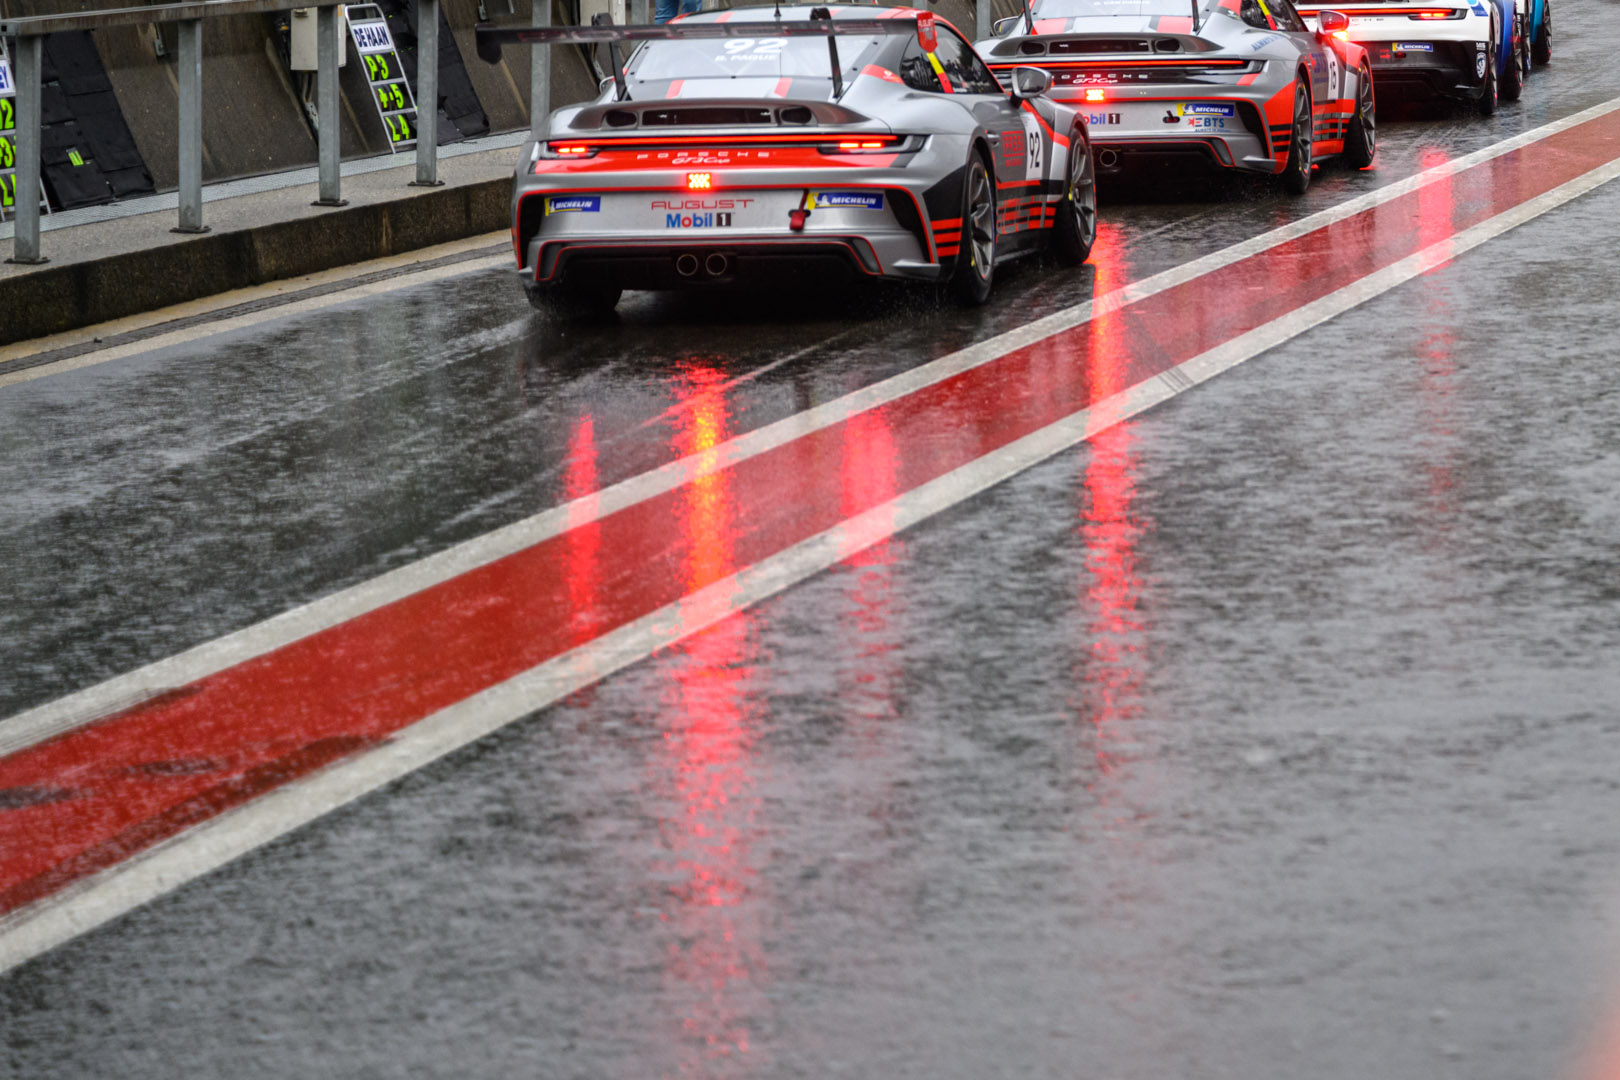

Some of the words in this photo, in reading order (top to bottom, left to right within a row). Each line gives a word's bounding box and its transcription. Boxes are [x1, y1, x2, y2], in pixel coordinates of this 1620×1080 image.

[353, 27, 368, 48] DE
[364, 25, 390, 47] HAAN
[723, 38, 789, 55] 92
[364, 54, 389, 81] P3
[1329, 61, 1337, 90] 15
[1195, 106, 1229, 114] MICHELIN
[385, 114, 410, 141] L4
[637, 150, 770, 160] PORSCHE
[1029, 131, 1040, 169] 92
[555, 199, 593, 210] MICHELIN
[650, 199, 755, 211] AUGUST
[831, 195, 878, 206] MICHELIN
[666, 213, 713, 229] Mobil
